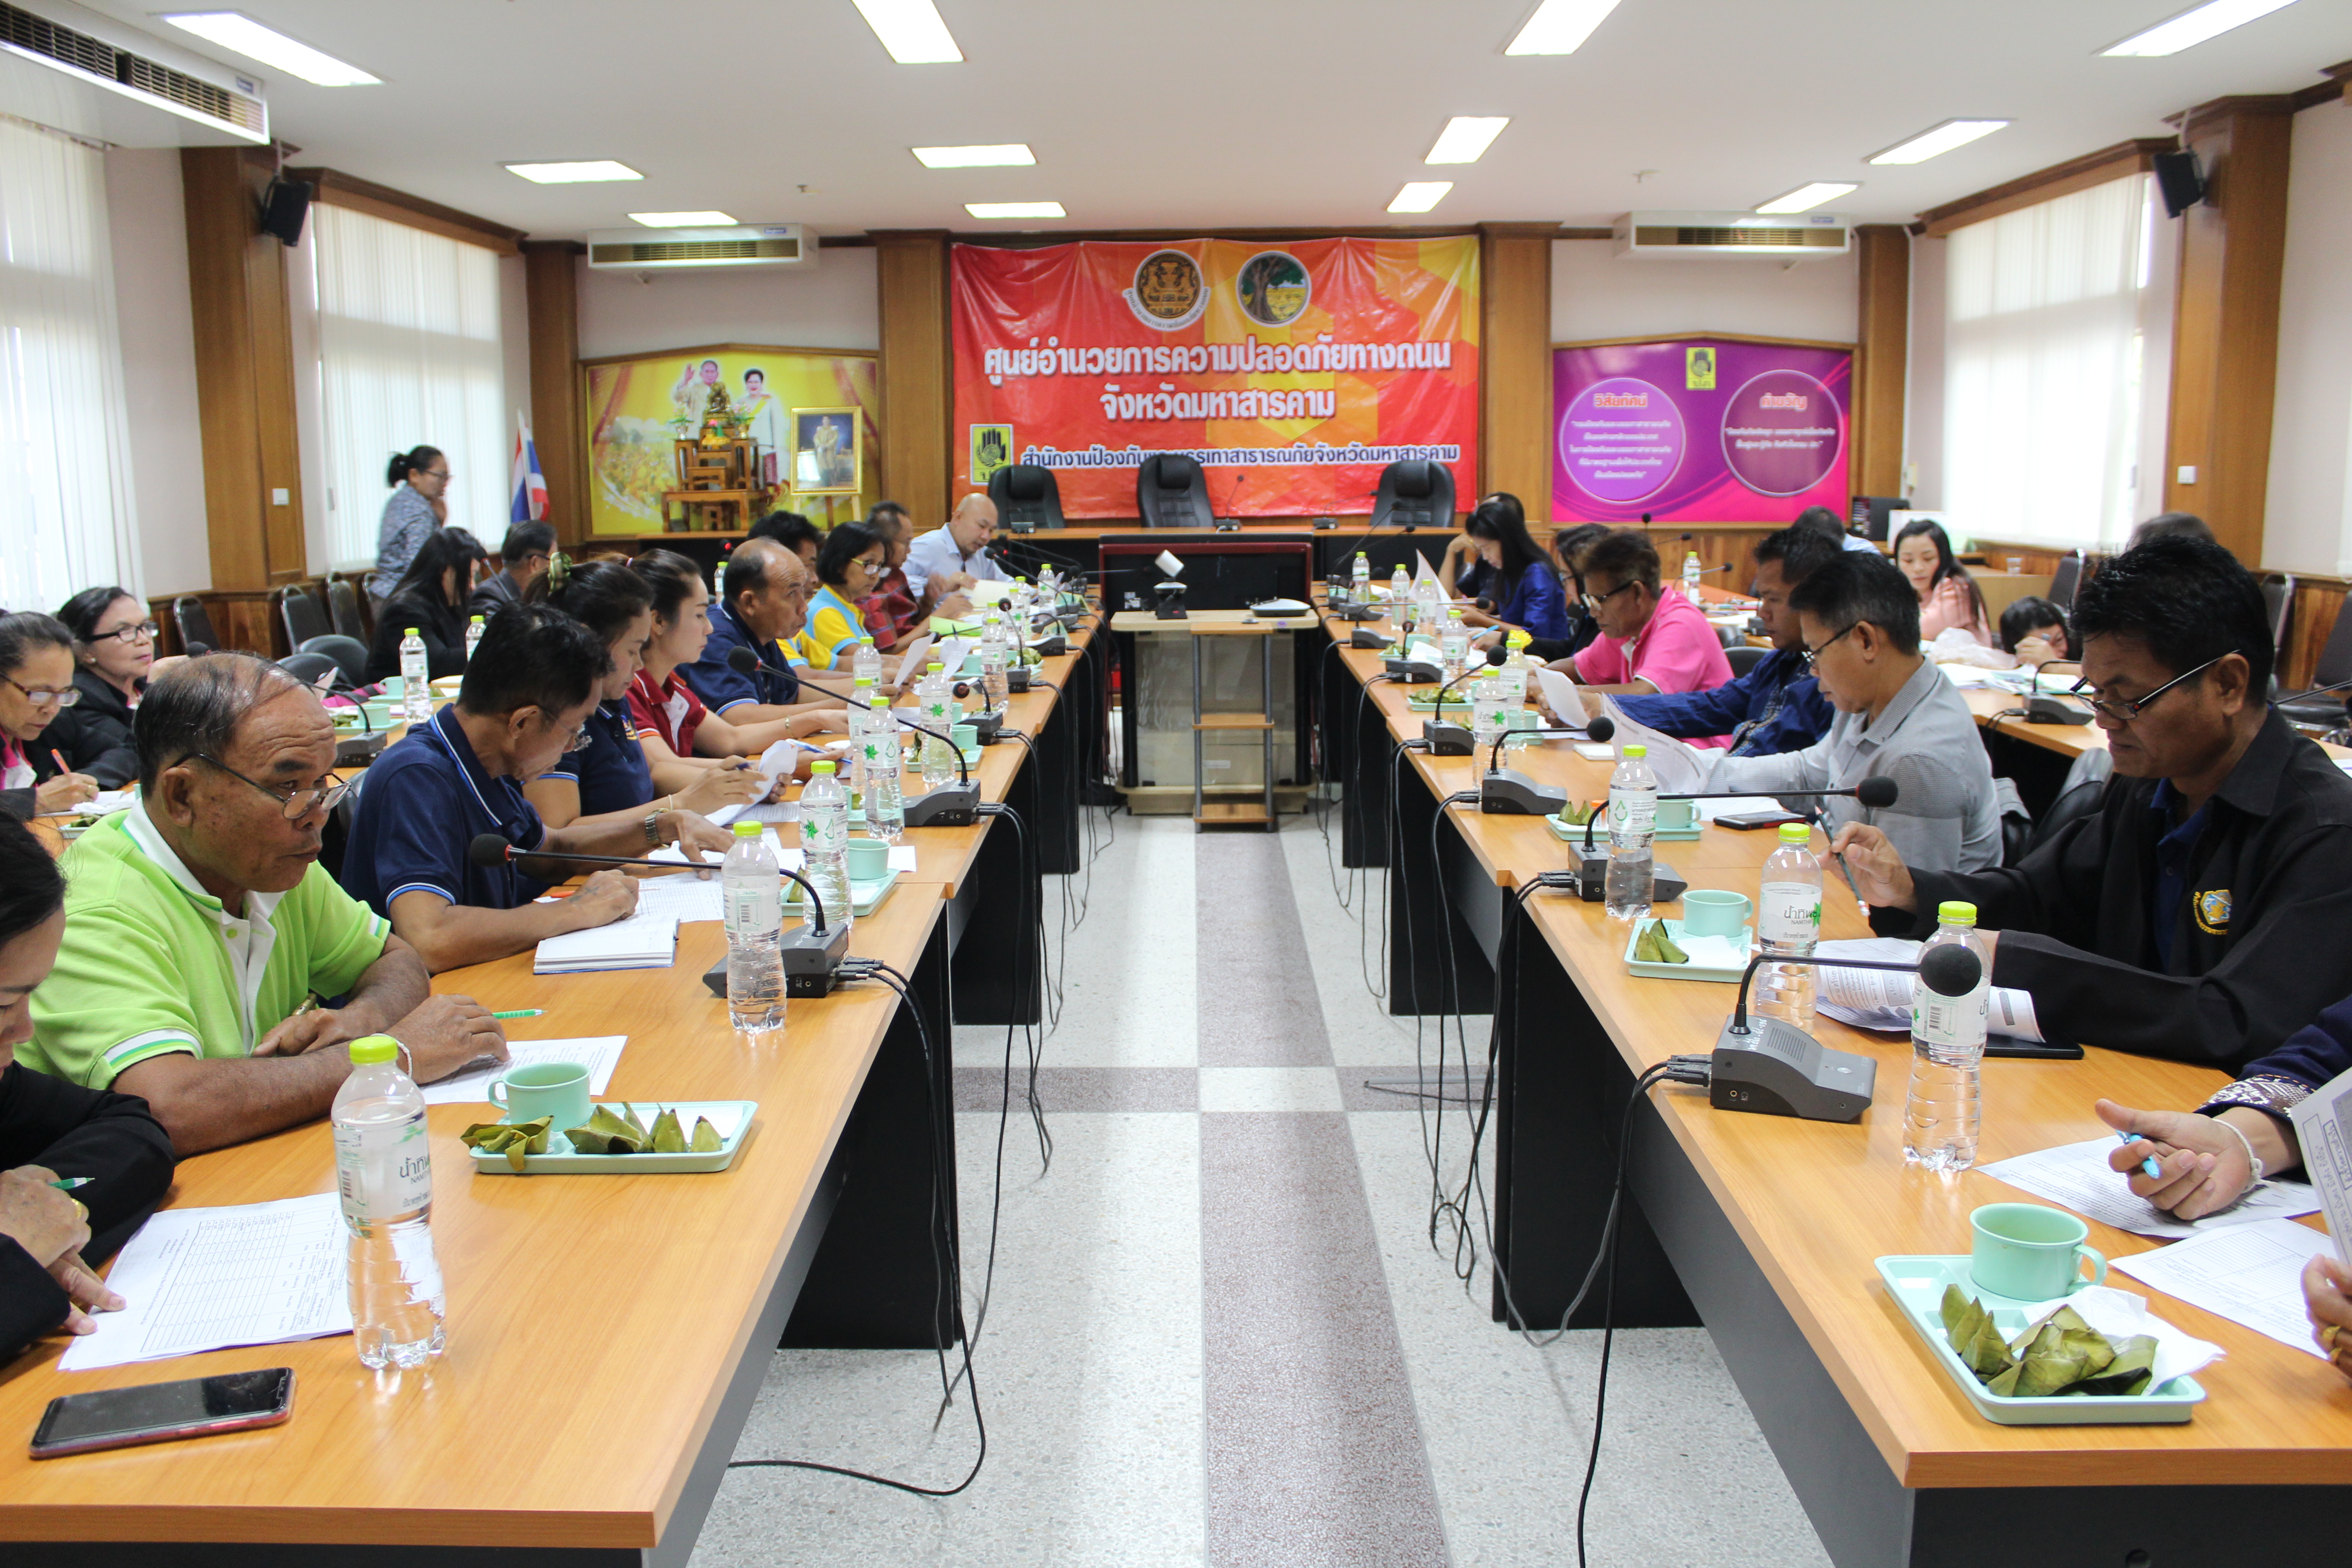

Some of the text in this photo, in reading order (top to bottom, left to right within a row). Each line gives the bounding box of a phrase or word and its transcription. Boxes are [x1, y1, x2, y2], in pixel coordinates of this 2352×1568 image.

[984, 333, 1450, 387] ศูนย์อำนวยการความปลอดภัยทางถนน
[1099, 382, 1335, 421] จังหวัดมหาสารคาม
